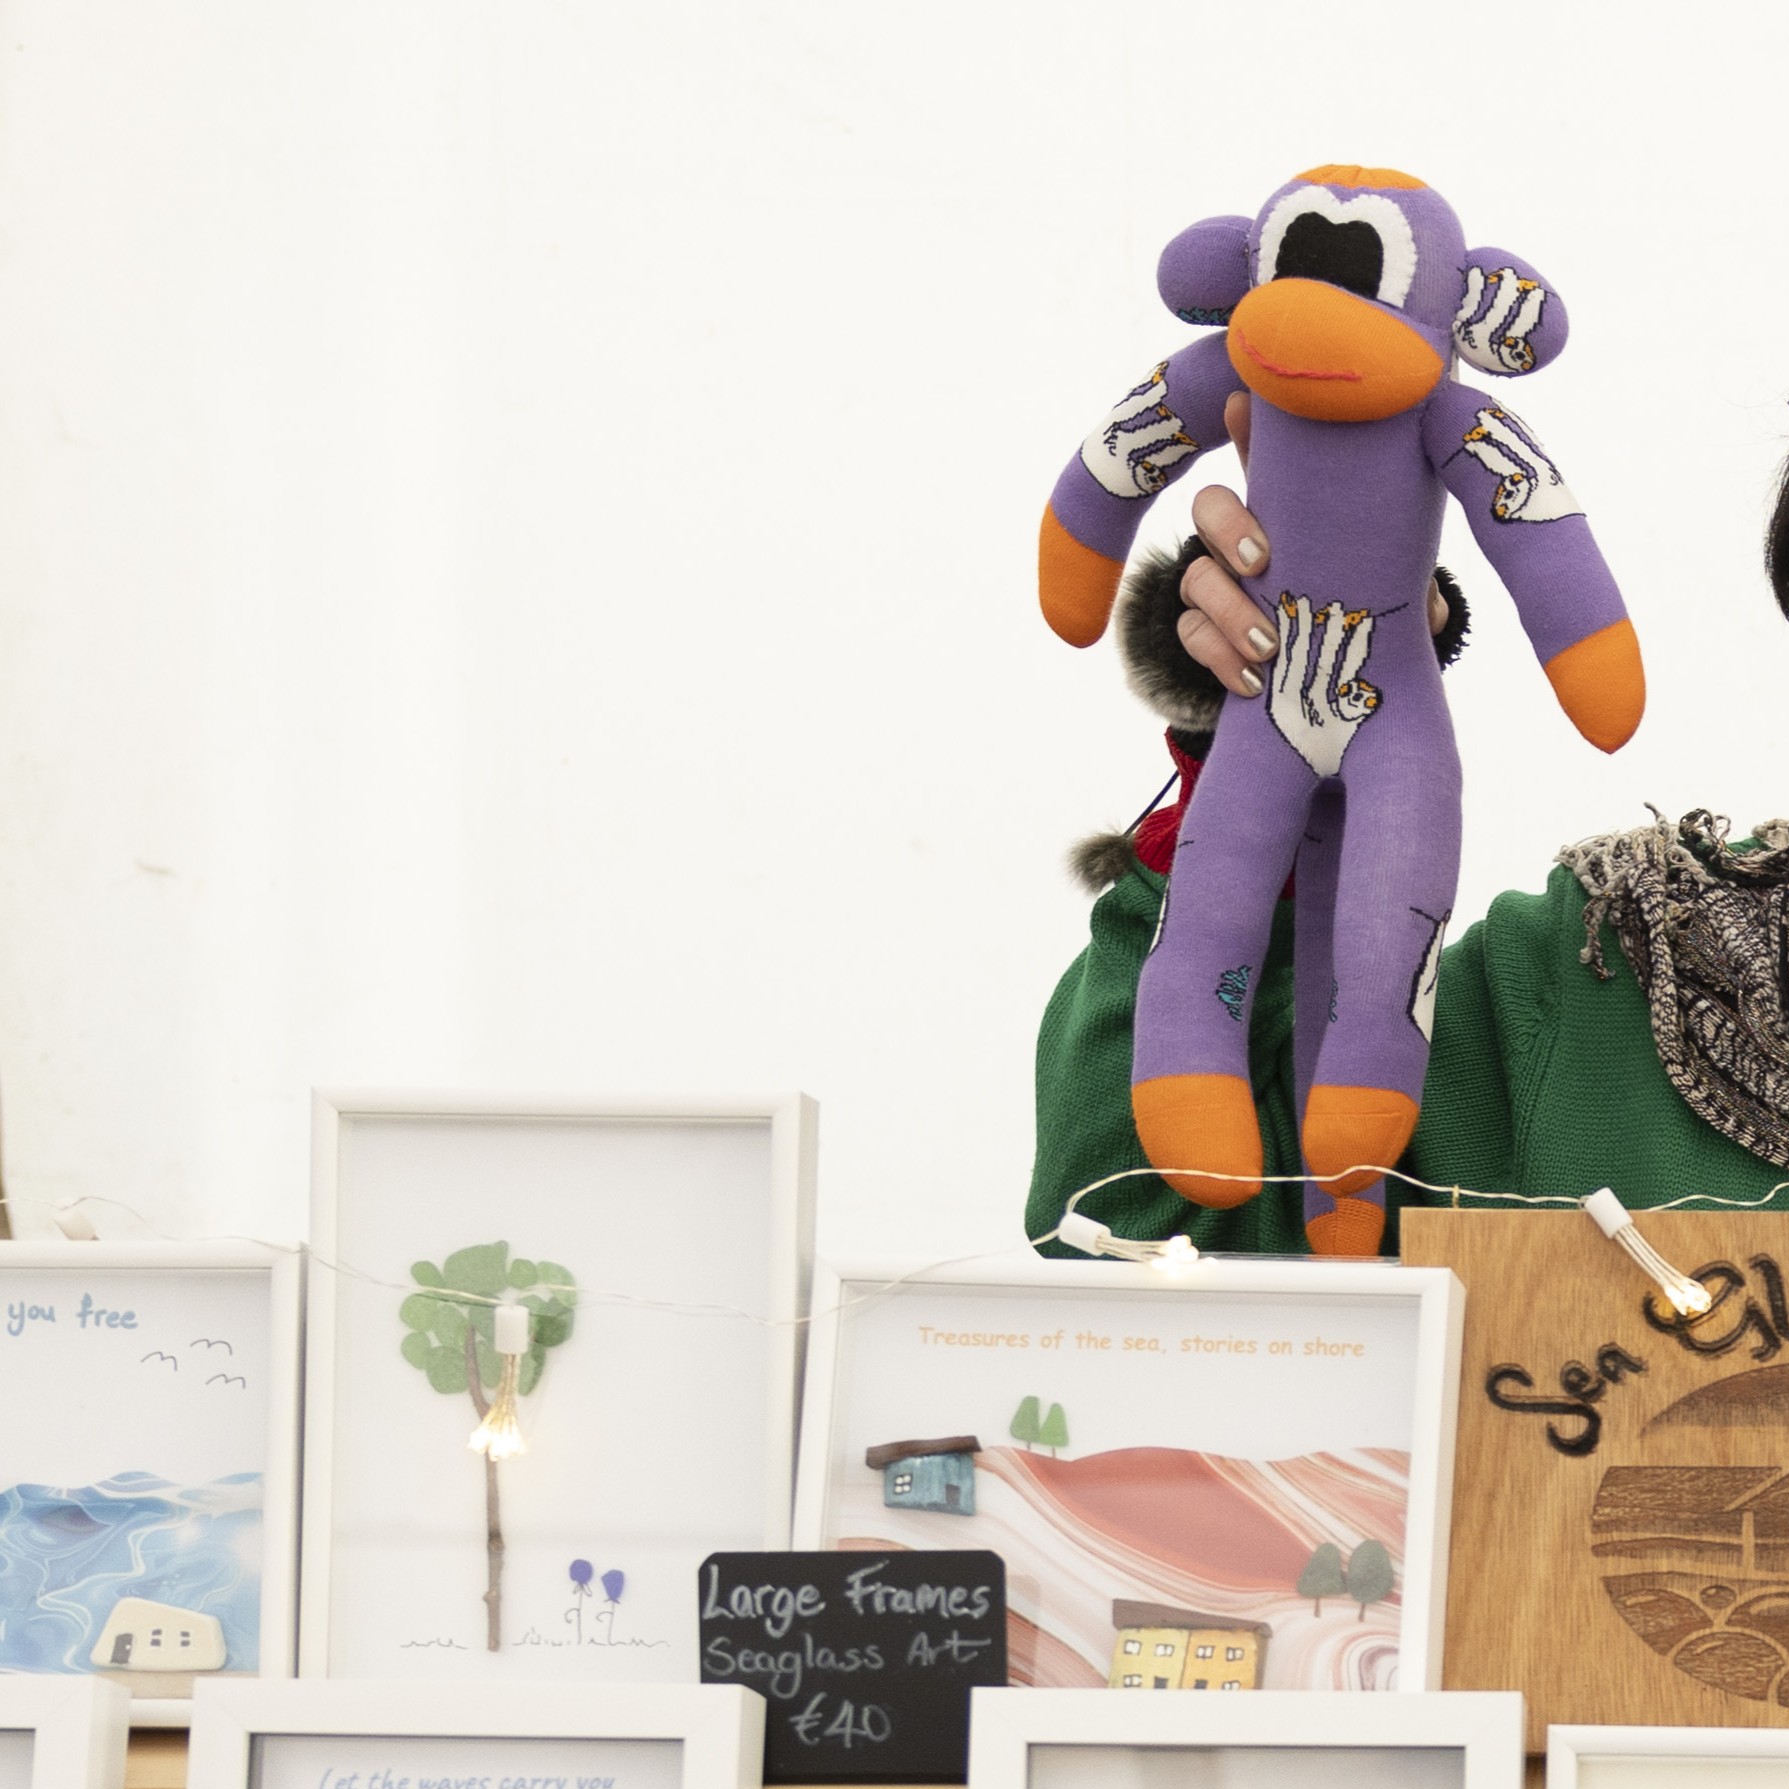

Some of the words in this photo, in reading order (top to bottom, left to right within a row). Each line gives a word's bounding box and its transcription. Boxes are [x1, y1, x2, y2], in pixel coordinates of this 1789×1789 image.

[7, 1300, 56, 1336] you
[76, 1292, 138, 1329] free
[918, 1326, 1030, 1349] Treasures
[1040, 1330, 1066, 1350] of
[1075, 1330, 1111, 1350] the
[1122, 1334, 1168, 1354] sea,
[1181, 1335, 1258, 1355] stories
[1268, 1341, 1293, 1355] on
[1303, 1337, 1365, 1357] shore
[1485, 1341, 1648, 1457] Sea
[702, 1563, 826, 1639] Large
[845, 1559, 991, 1619] Frames
[704, 1633, 884, 1699] Seaglass
[907, 1630, 991, 1666] Art
[789, 1691, 892, 1748] €40
